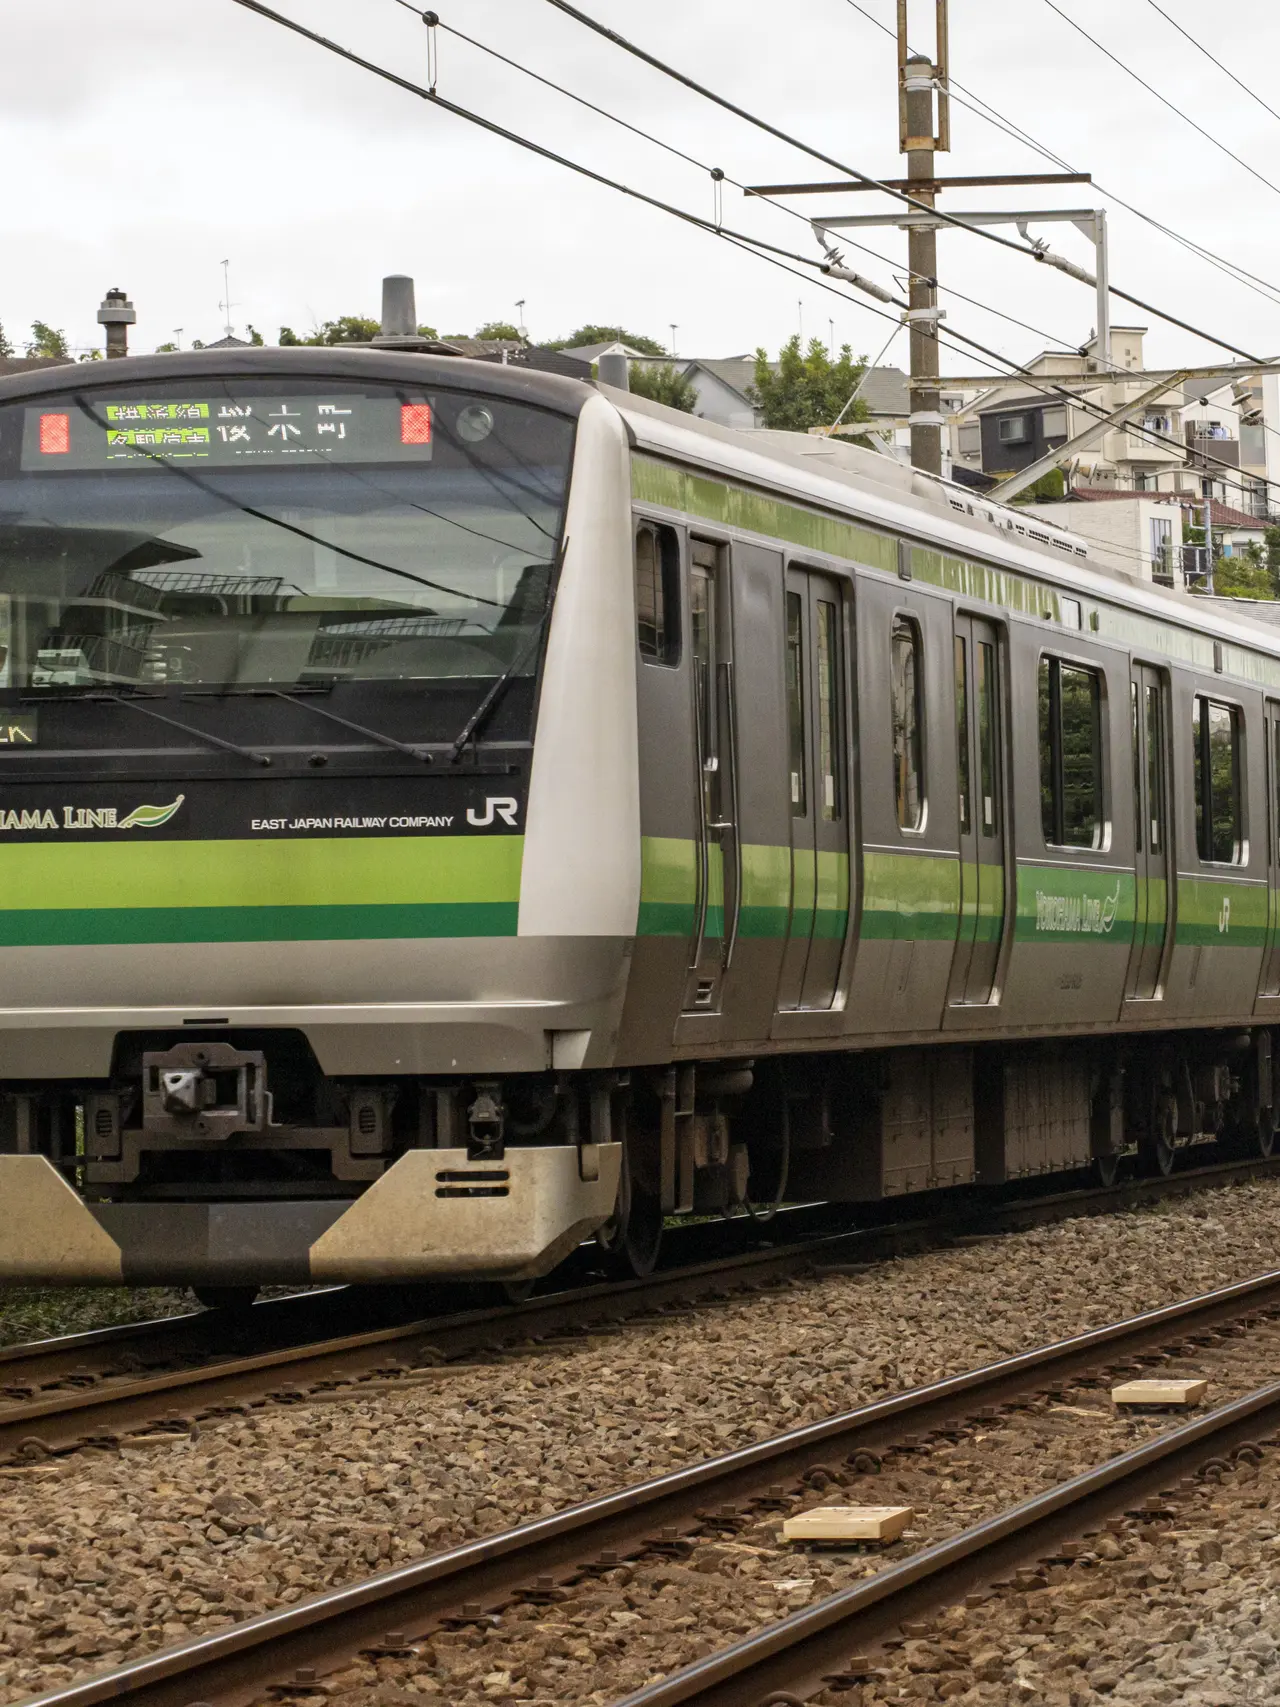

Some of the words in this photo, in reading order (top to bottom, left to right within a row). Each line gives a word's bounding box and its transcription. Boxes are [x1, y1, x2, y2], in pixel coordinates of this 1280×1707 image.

[0, 808, 60, 829] AMA
[251, 818, 287, 830] EAST
[288, 817, 333, 830] JAPAN
[334, 816, 388, 829] RAILWAY
[388, 816, 454, 828] COMPANY
[466, 796, 518, 827] JR
[1218, 895, 1230, 933] JR
